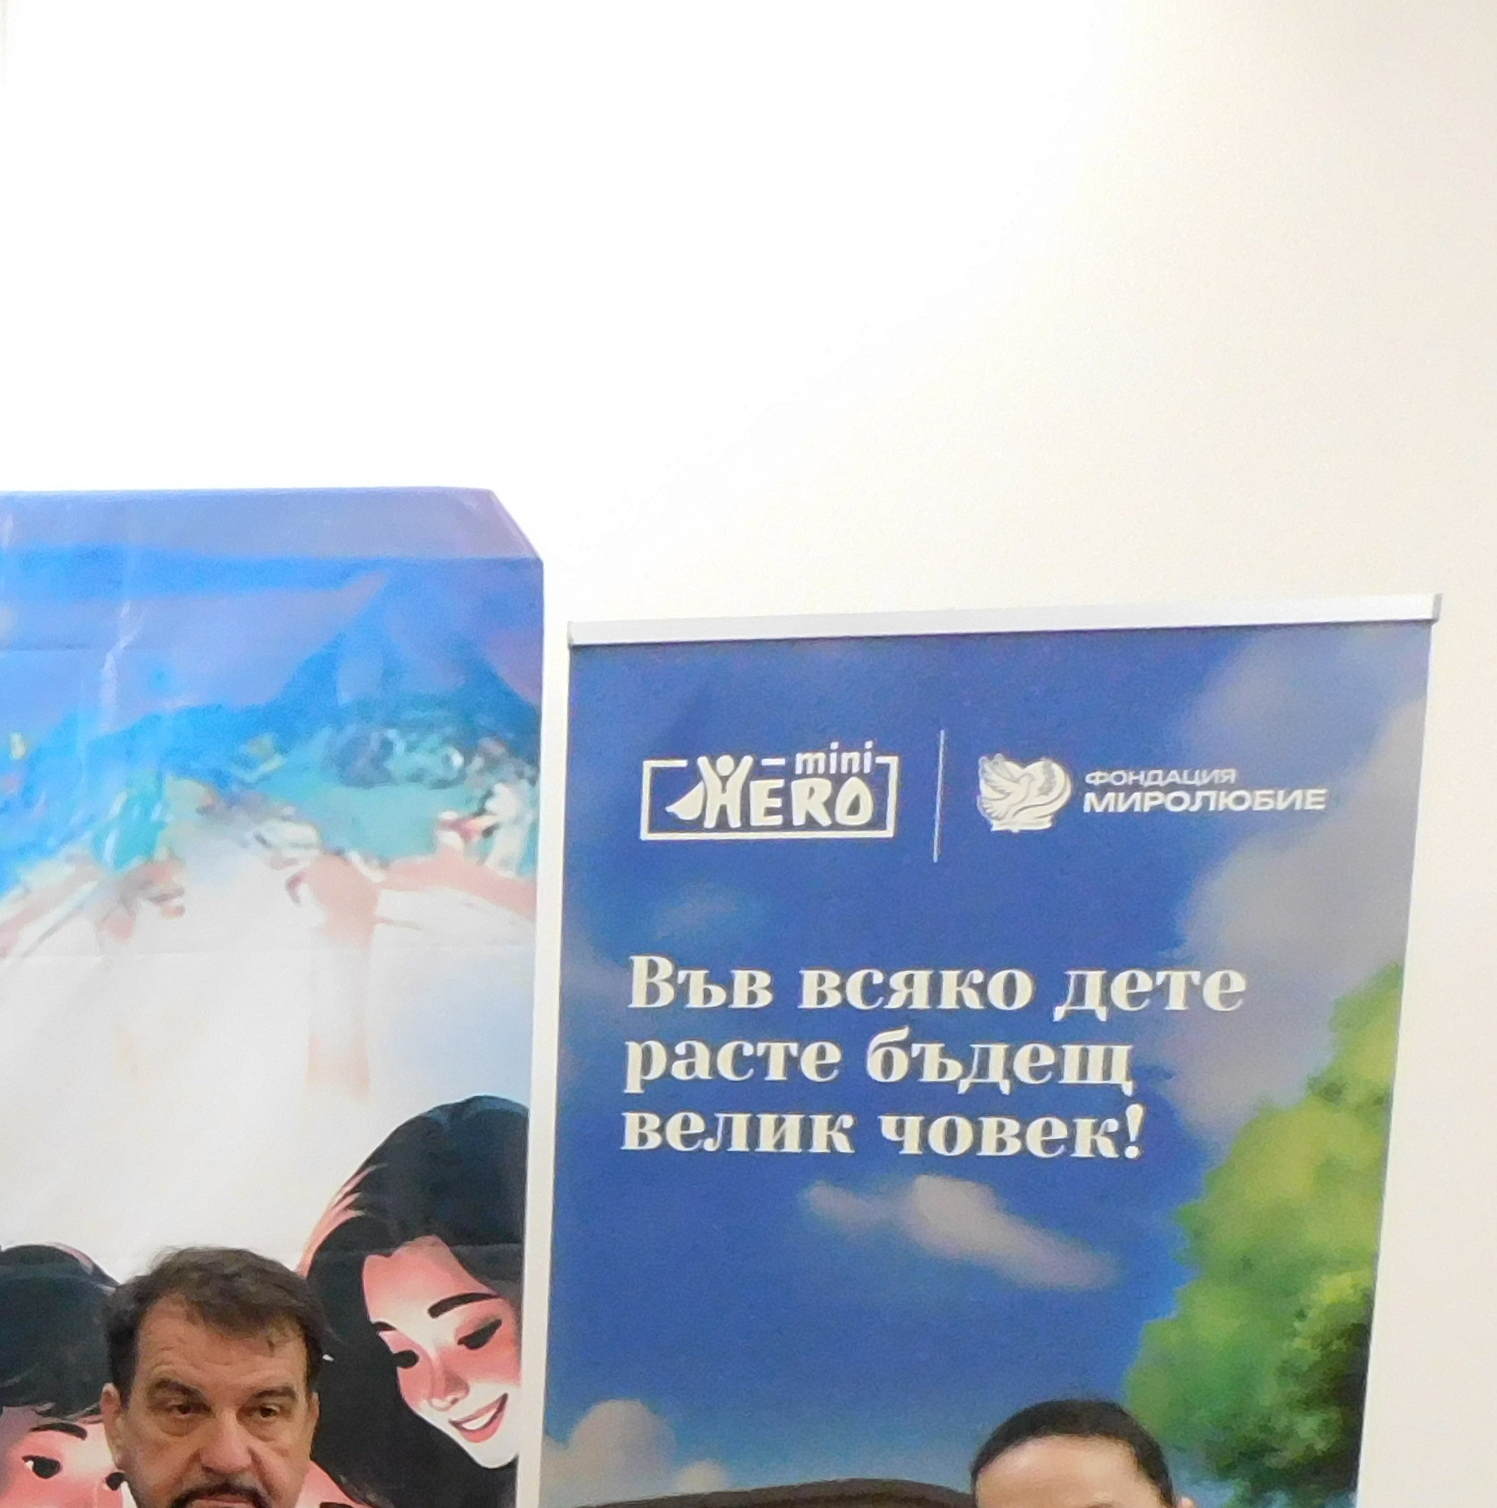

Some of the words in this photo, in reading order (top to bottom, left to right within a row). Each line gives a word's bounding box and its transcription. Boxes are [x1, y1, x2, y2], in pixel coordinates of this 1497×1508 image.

[795, 740, 873, 774] mini
[1084, 768, 1237, 787] ФОНДАЦИЯ
[697, 755, 874, 829] HERO
[1082, 789, 1327, 814] МИРОЛЮБИЕ
[628, 955, 773, 1010] Във
[797, 967, 1032, 1012] всяко
[1053, 967, 1246, 1022] дете
[623, 1037, 842, 1094] расте
[866, 1026, 1133, 1096] бъдещ
[621, 1107, 855, 1154] велик
[879, 1103, 1145, 1158] човек!
